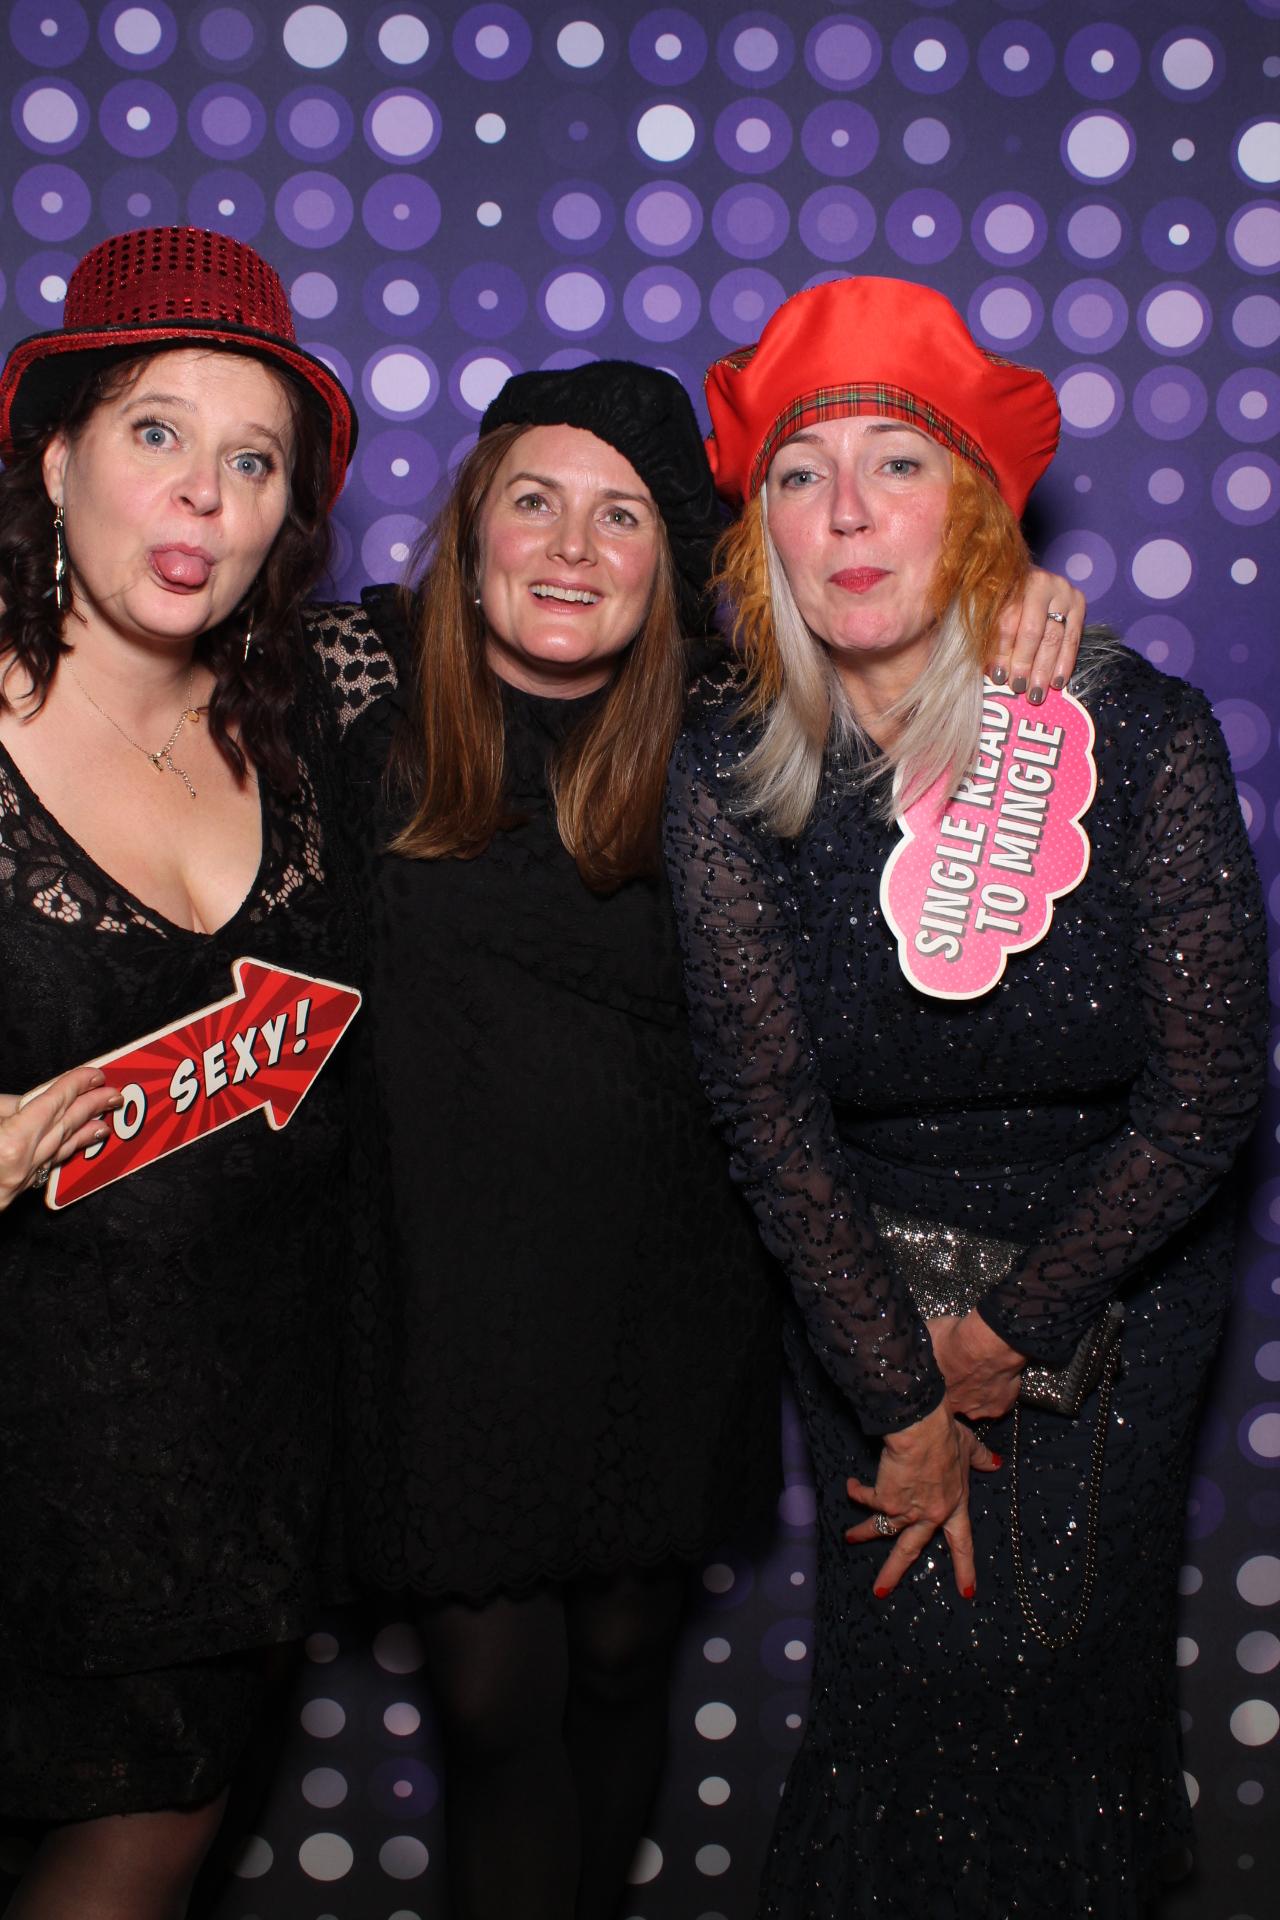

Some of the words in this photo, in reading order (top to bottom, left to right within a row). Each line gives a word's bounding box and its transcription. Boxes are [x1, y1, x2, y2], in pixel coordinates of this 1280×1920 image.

[989, 718, 1064, 875] MINGLE
[914, 815, 987, 960] SINGLE
[974, 883, 1028, 934] TO
[84, 1083, 147, 1160] O
[169, 998, 311, 1114] SEXY!
